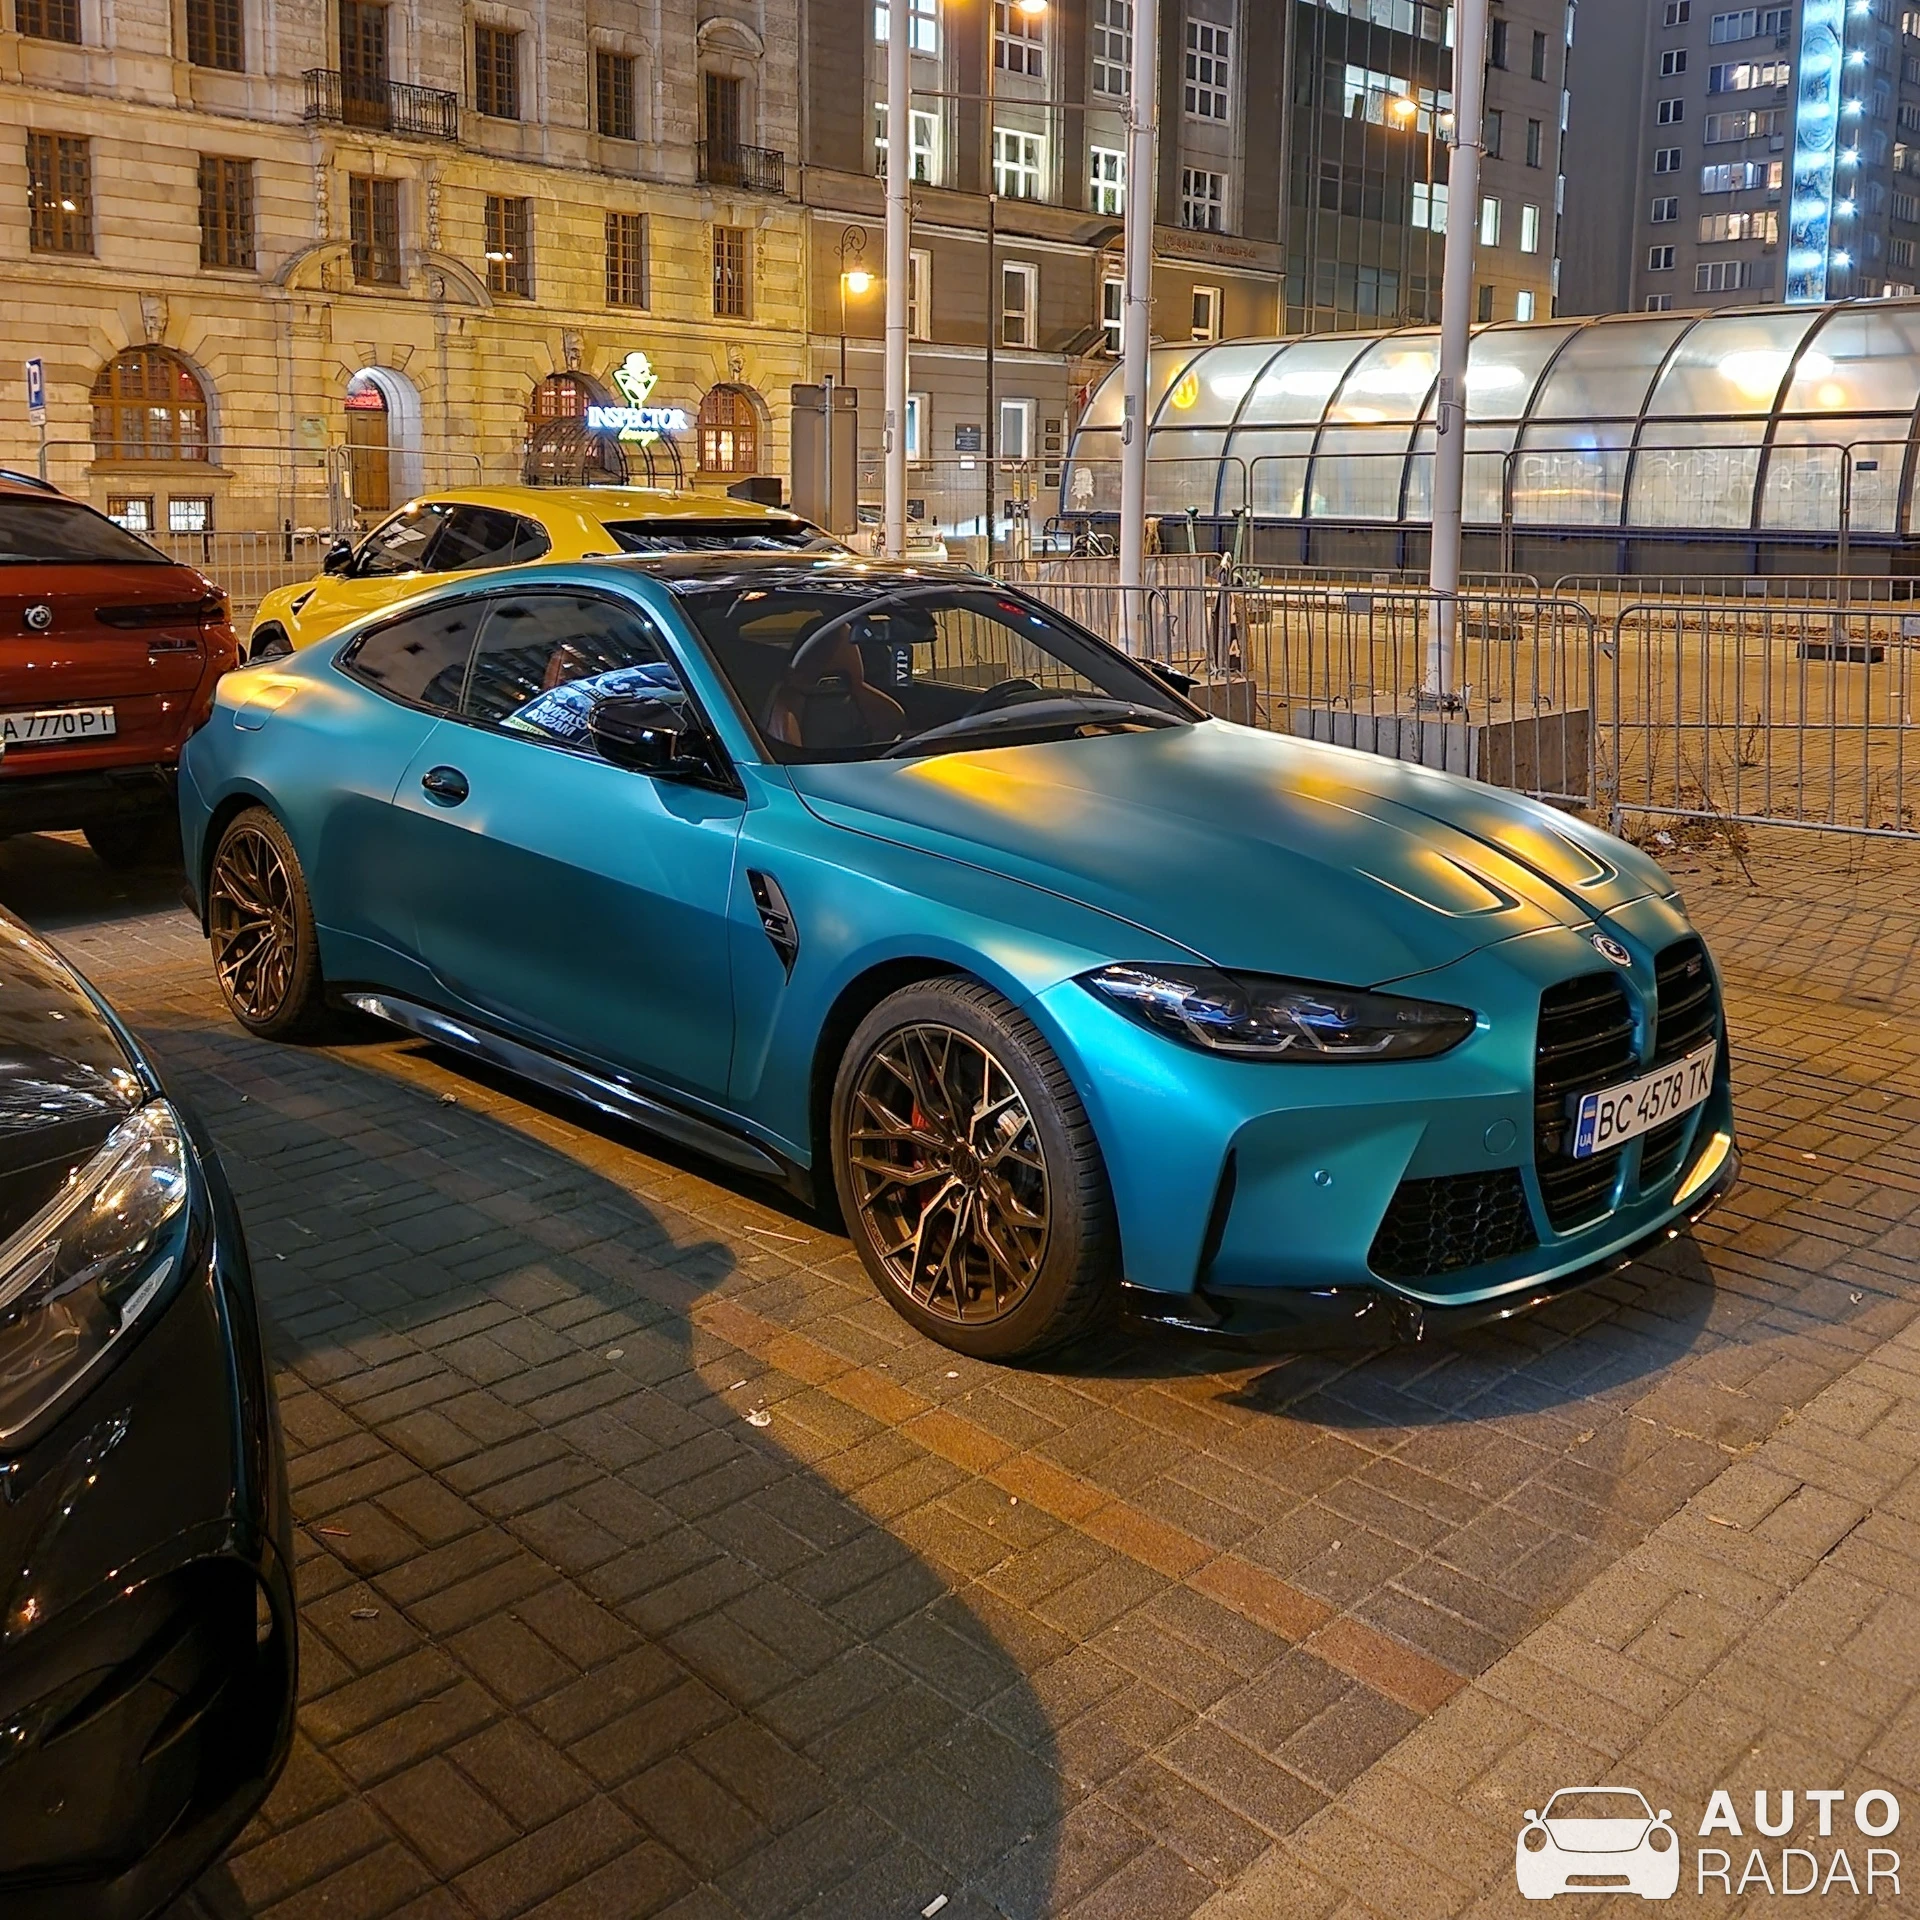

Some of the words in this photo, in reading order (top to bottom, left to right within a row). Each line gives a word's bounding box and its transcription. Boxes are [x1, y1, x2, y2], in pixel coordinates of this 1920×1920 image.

[30, 364, 40, 403] P
[588, 406, 688, 430] INSPECTOR
[896, 649, 908, 681] VIP
[1598, 1094, 1634, 1142] BC
[1637, 1071, 1683, 1124] 4578
[1690, 1054, 1713, 1099] TK
[1579, 1134, 1593, 1147] UA
